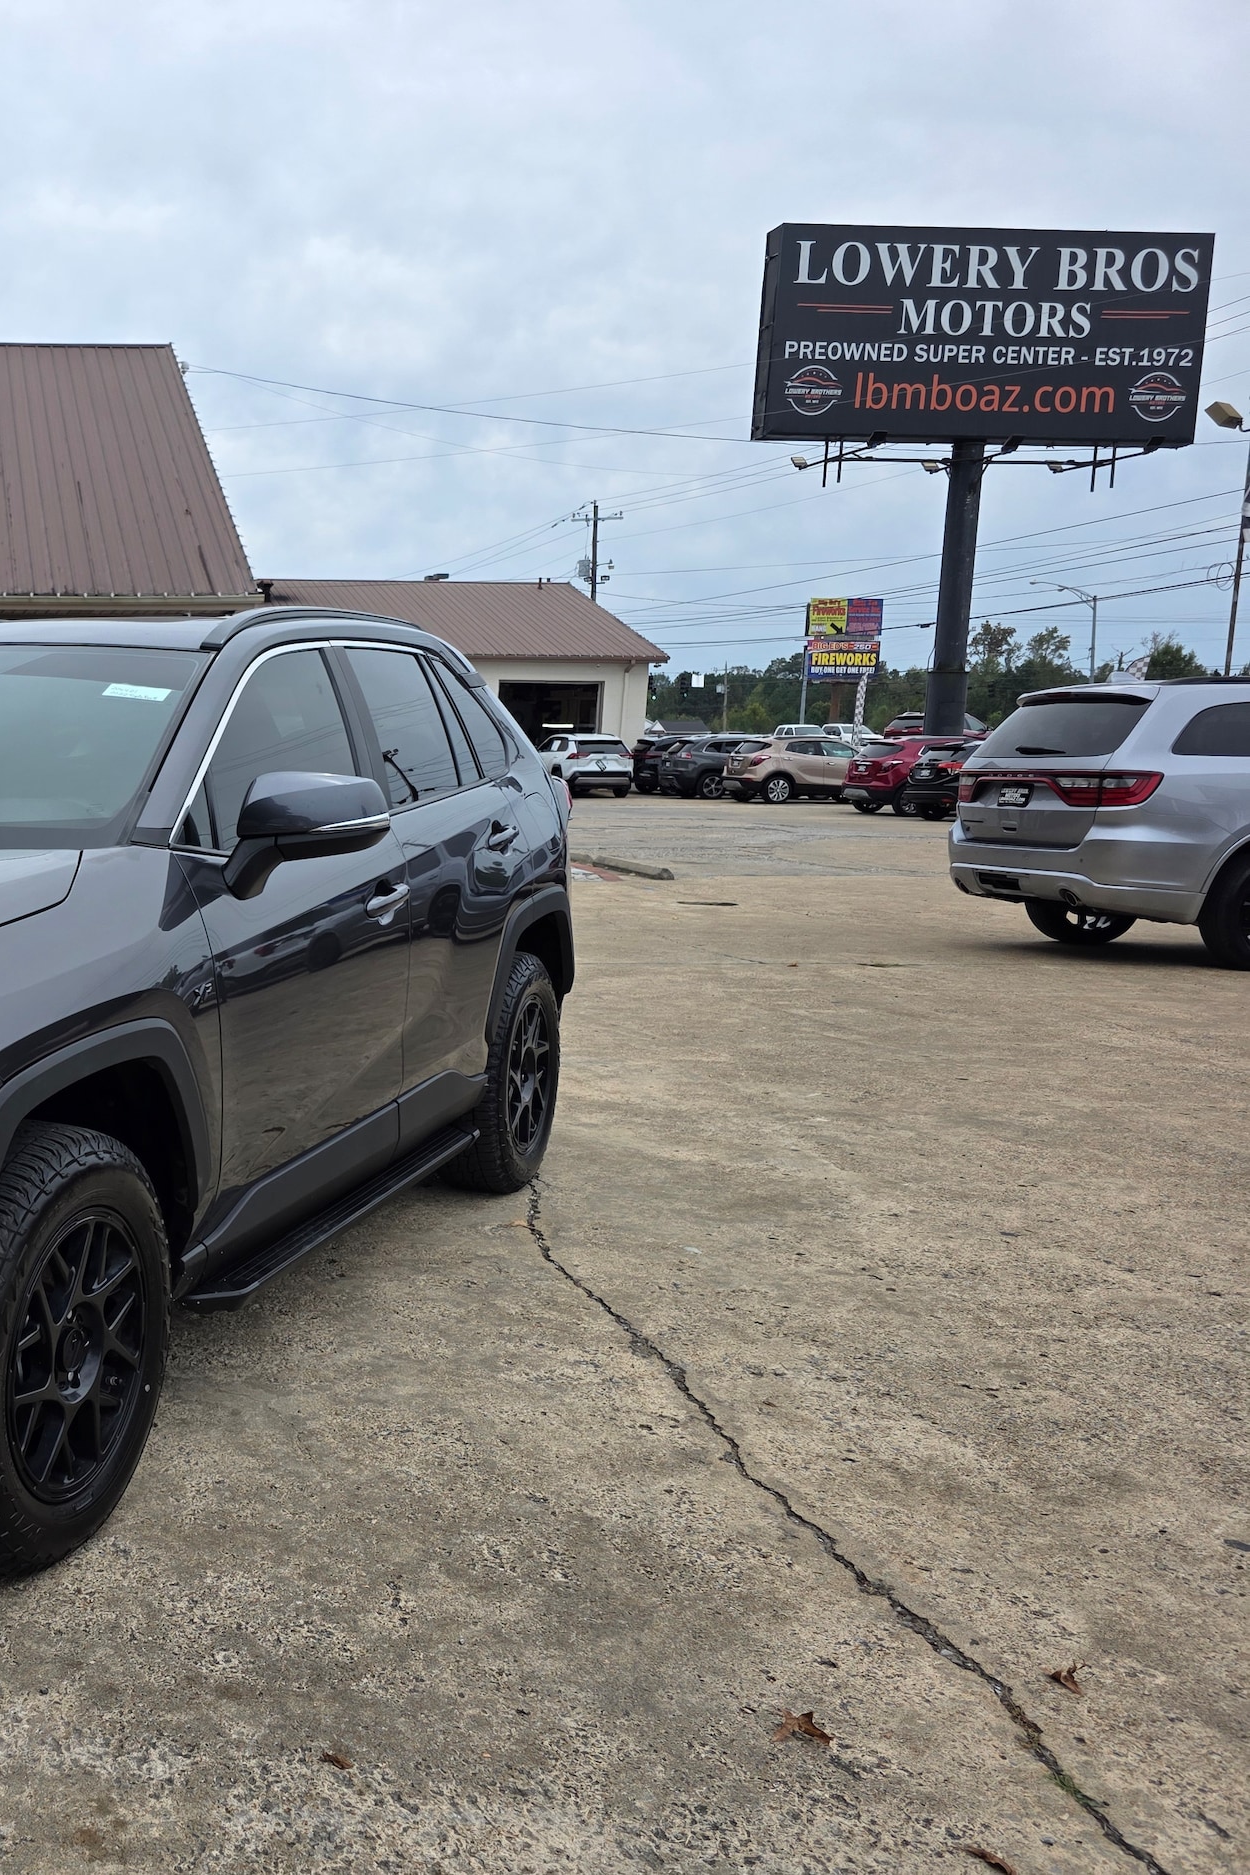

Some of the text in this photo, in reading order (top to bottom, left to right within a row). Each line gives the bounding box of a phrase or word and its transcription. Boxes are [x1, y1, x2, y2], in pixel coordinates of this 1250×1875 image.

[793, 240, 1199, 293] LOWERY BROS
[896, 299, 1091, 338] MOTORS
[784, 340, 908, 362] PREOWNED
[914, 344, 986, 363] SUPER
[992, 345, 1075, 365] CENTER
[1094, 347, 1194, 367] EST.1972
[810, 388, 842, 396] BROTHERS
[854, 371, 1115, 414] lbmboaz.com
[812, 641, 829, 650] BIG
[829, 641, 849, 651] ED'S
[812, 653, 877, 666] FIREWORKS
[823, 666, 835, 674] ONE
